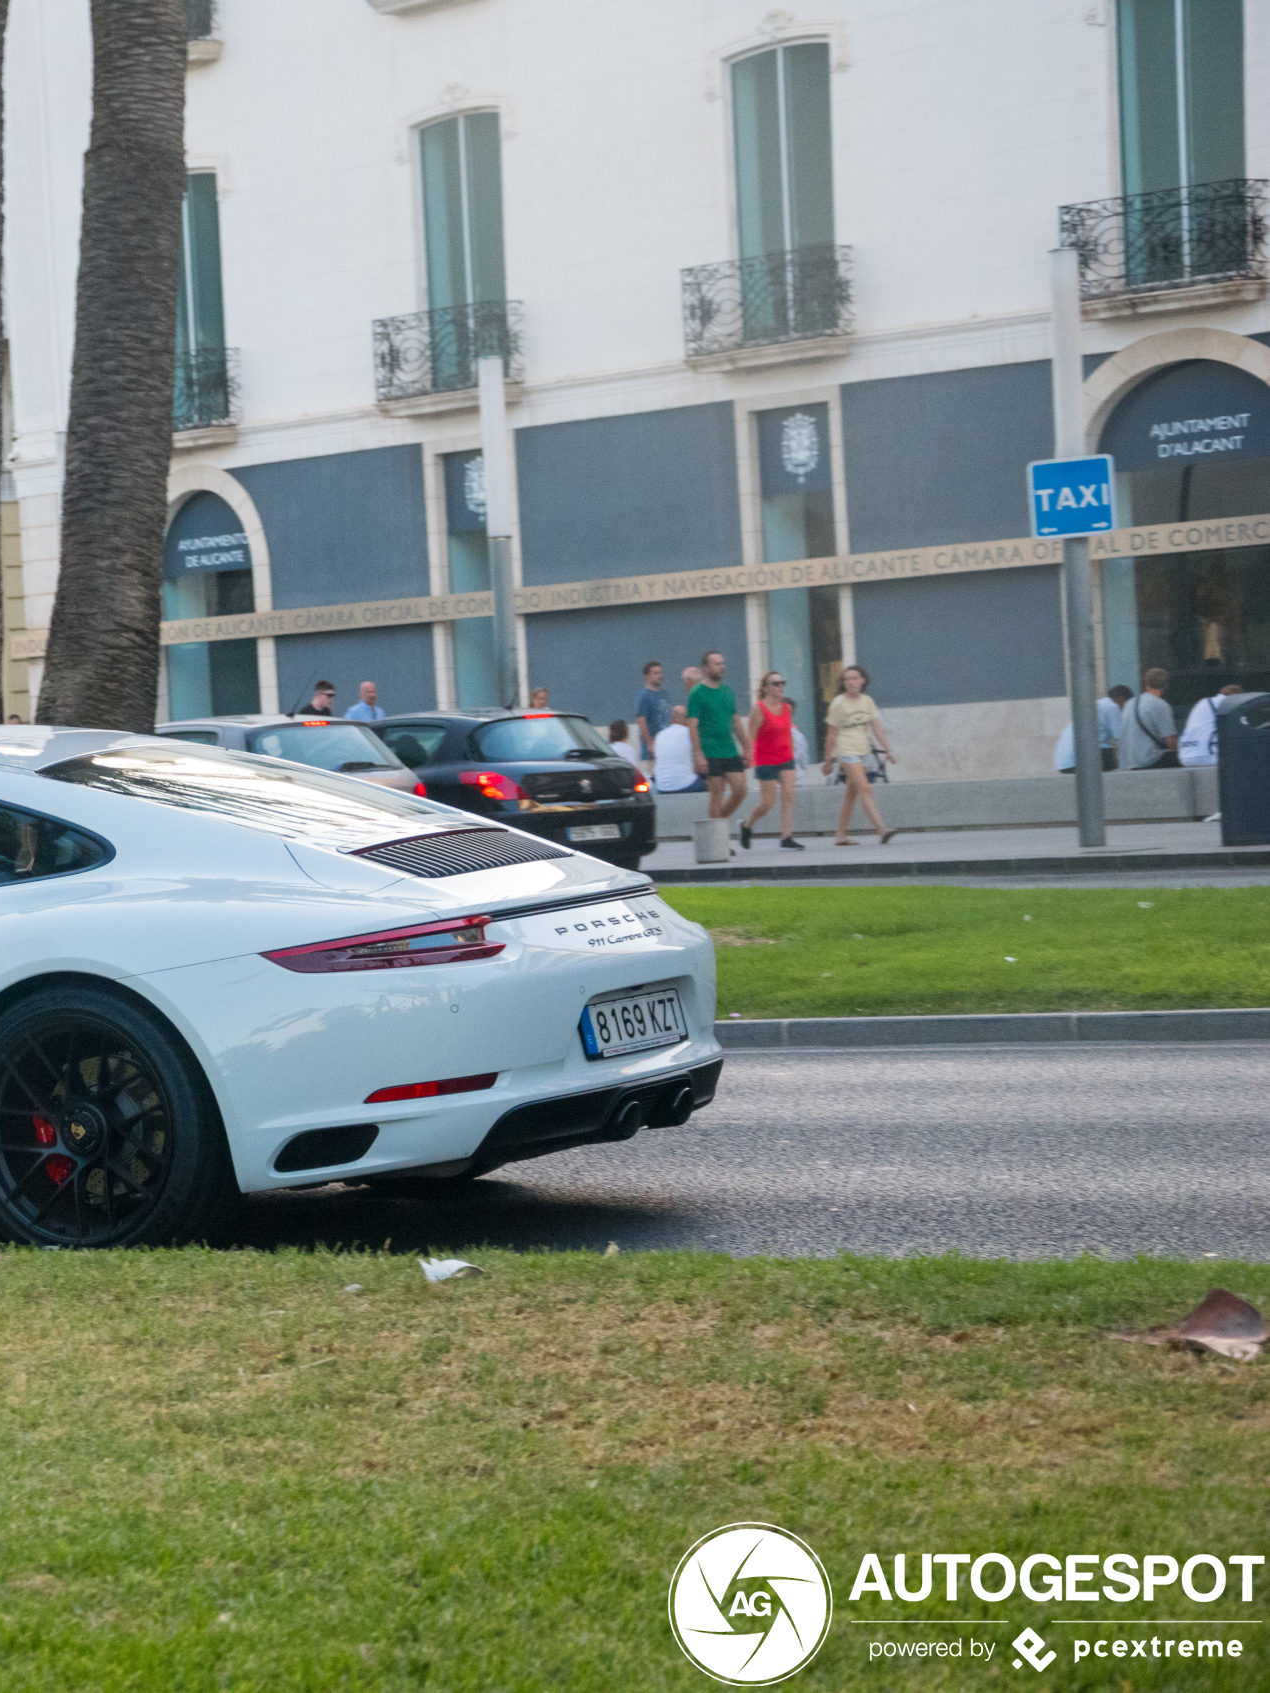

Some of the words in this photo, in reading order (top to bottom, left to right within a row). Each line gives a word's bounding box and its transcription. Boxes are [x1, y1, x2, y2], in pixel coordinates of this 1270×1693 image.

[1150, 413, 1251, 441] AJUNTAMENT
[1157, 435, 1245, 459] D'ALACANT
[1035, 483, 1109, 512] TAXI
[215, 616, 286, 636] ALICANTE
[429, 600, 449, 618] DE
[790, 564, 814, 584] DE
[819, 553, 920, 580] ALICANTE
[1130, 531, 1158, 551] DE
[554, 910, 661, 936] PORSCHE
[588, 937, 606, 947] 911
[607, 932, 643, 945] Carrera
[643, 926, 663, 938] GTS
[596, 1004, 647, 1043] 8169
[647, 997, 680, 1034] KZT
